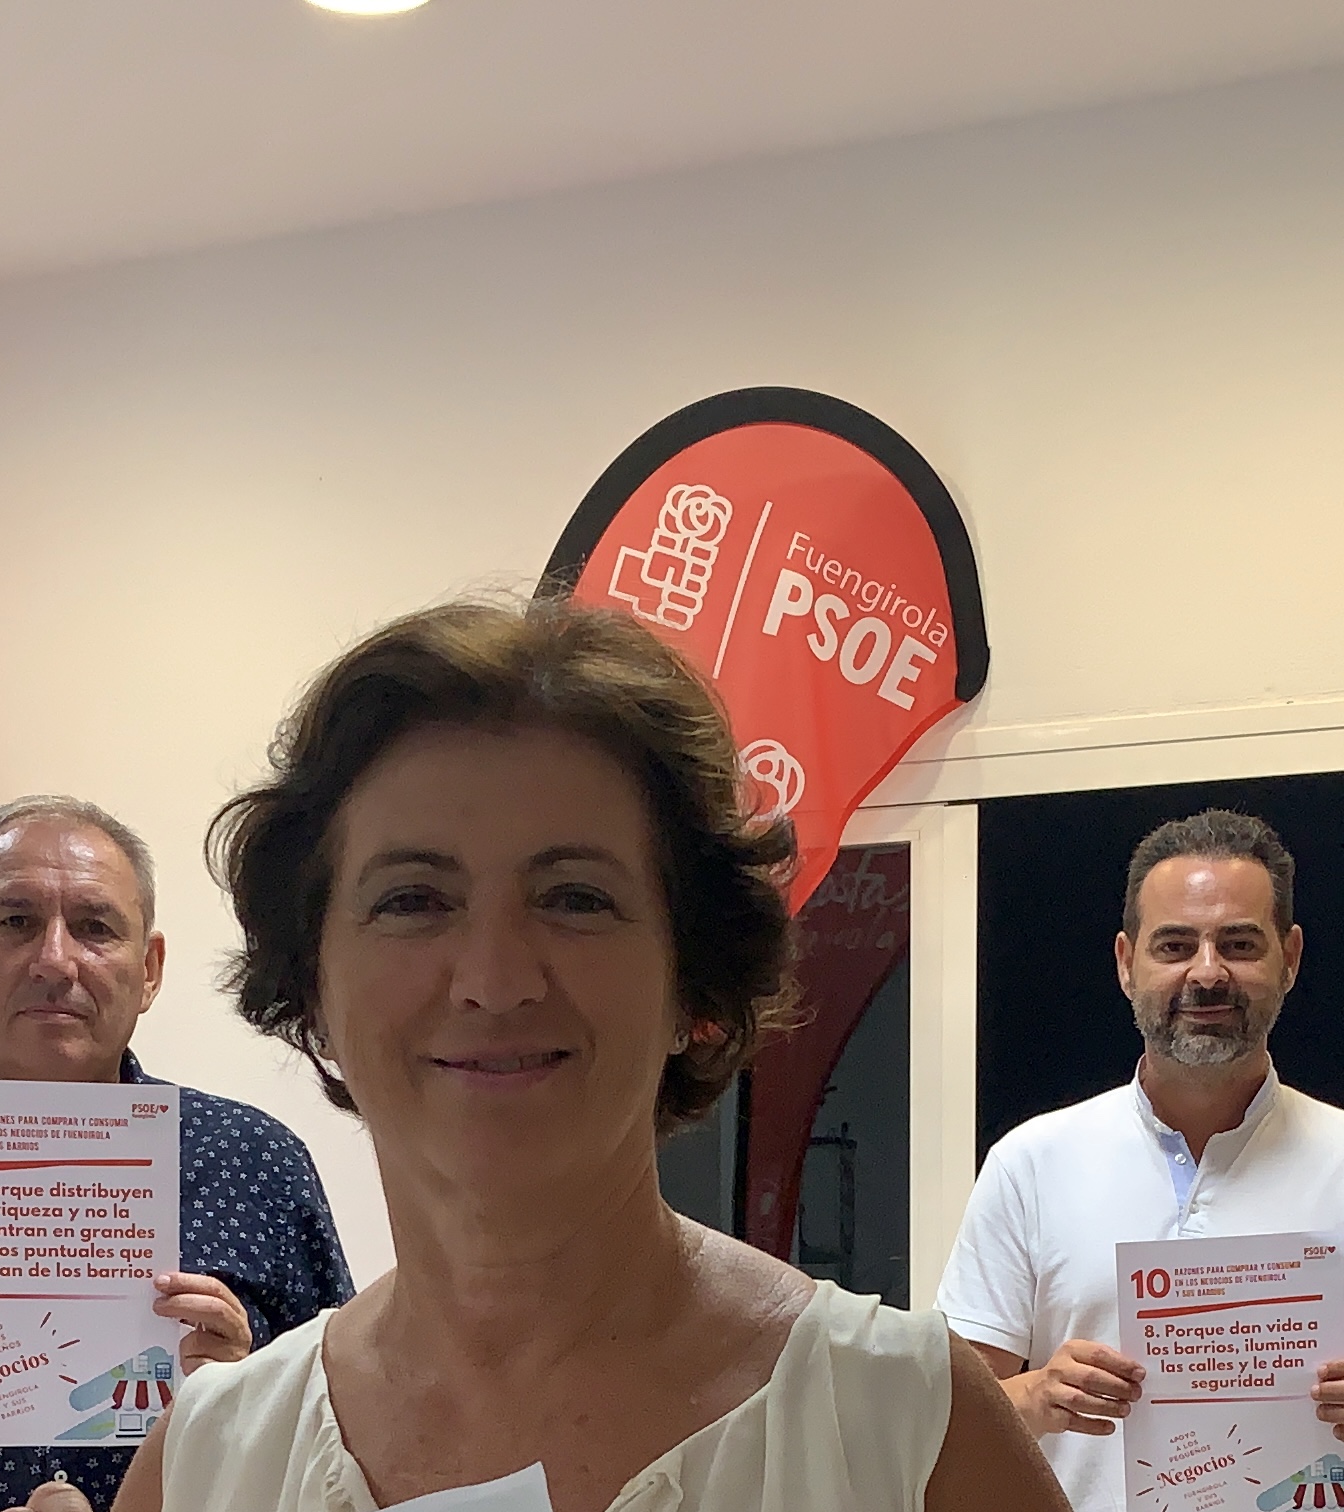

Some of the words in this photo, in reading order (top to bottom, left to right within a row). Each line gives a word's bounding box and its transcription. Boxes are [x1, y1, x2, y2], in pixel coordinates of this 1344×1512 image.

[786, 531, 949, 647] Fuengirola
[762, 568, 938, 711] PSOE
[49, 1181, 153, 1203] distribuyen
[68, 1207, 80, 1222] y
[85, 1207, 108, 1219] no
[113, 1202, 130, 1219] la
[52, 1227, 75, 1238] en
[79, 1222, 155, 1243] grandes
[24, 1242, 115, 1261] puntuales
[119, 1248, 153, 1263] que
[27, 1261, 51, 1278] de
[56, 1261, 81, 1278] los
[87, 1262, 153, 1279] barrios
[1130, 1268, 1171, 1299] 10
[1144, 1324, 1161, 1339] 8.
[1164, 1324, 1225, 1340] Porque
[1229, 1320, 1262, 1335] dan
[1265, 1317, 1303, 1333] vida
[1307, 1320, 1318, 1331] a
[1146, 1341, 1170, 1356] los
[1173, 1339, 1240, 1355] barrios,
[1244, 1336, 1318, 1353] iluminan
[1160, 1359, 1184, 1373] las
[1188, 1357, 1234, 1373] calles
[1238, 1361, 1249, 1374] y
[1253, 1355, 1268, 1370] le
[1271, 1353, 1305, 1369] dan
[1191, 1372, 1275, 1393] seguridad
[1156, 1453, 1236, 1487] Negocios
